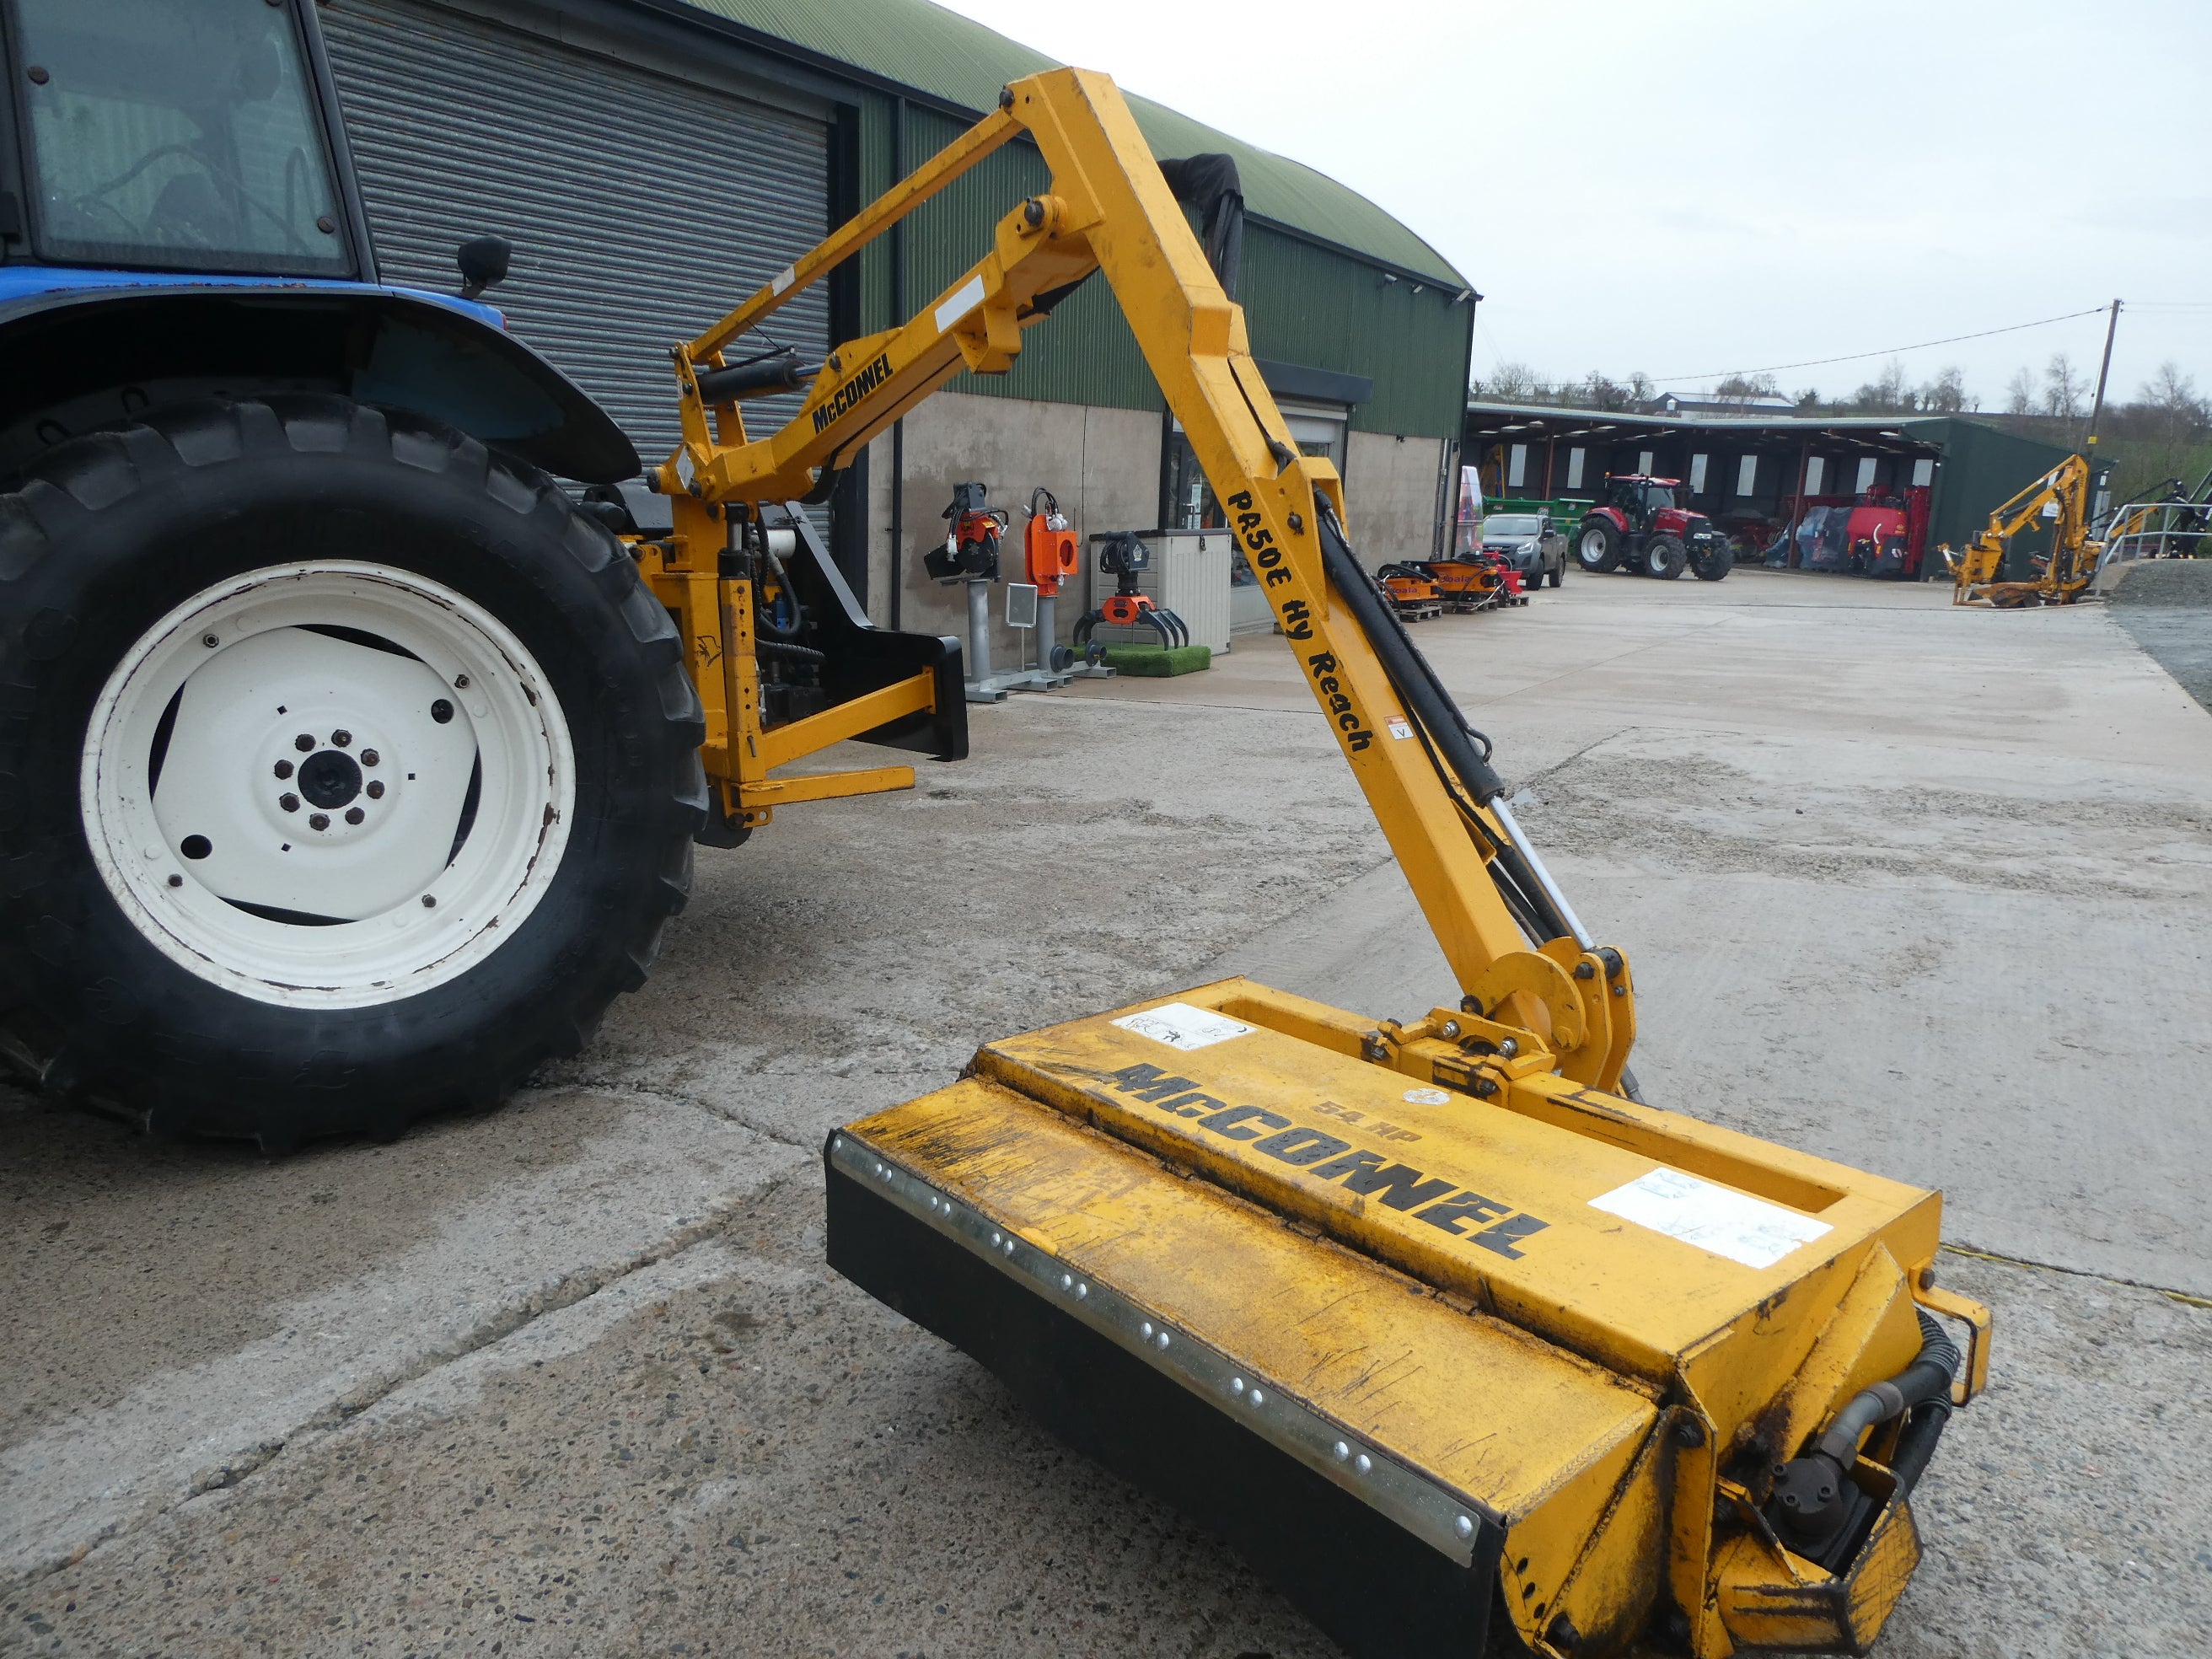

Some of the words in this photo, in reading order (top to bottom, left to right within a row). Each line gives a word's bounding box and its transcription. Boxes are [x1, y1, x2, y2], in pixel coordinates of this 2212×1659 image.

[1227, 489, 1293, 588] PA50E
[1281, 599, 1313, 641] Hy
[1308, 649, 1374, 752] Reach
[1310, 1100, 1366, 1125] 54
[1363, 1121, 1423, 1142] HP
